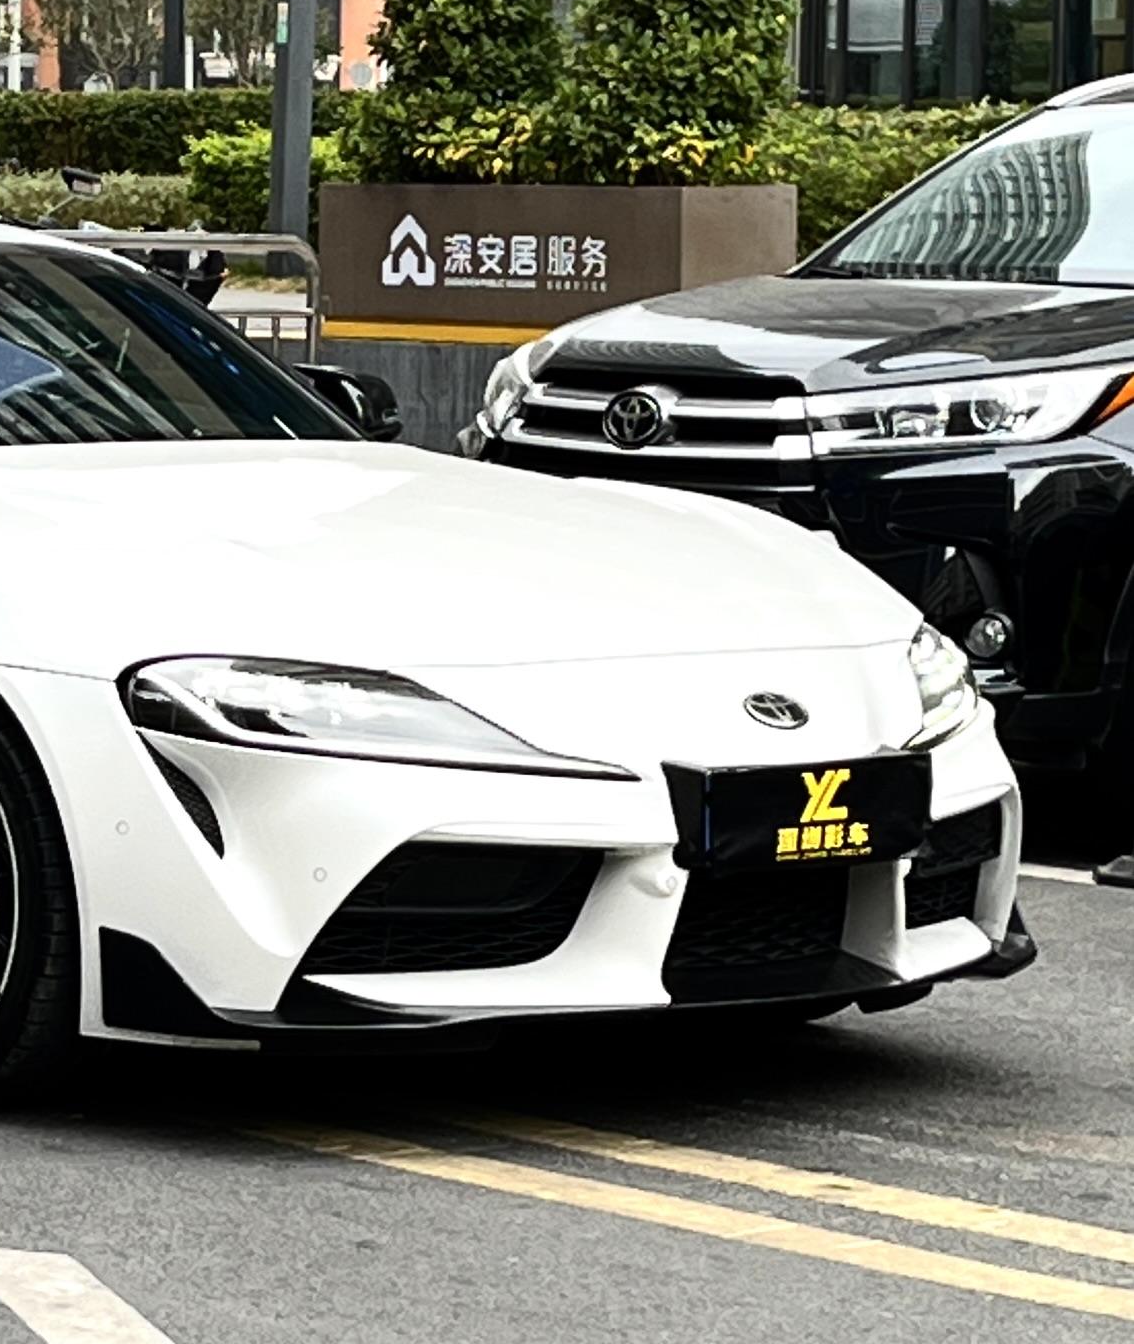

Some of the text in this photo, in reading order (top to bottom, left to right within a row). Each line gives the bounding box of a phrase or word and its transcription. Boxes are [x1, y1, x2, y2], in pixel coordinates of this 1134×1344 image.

[444, 234, 607, 278] 深安居 服务
